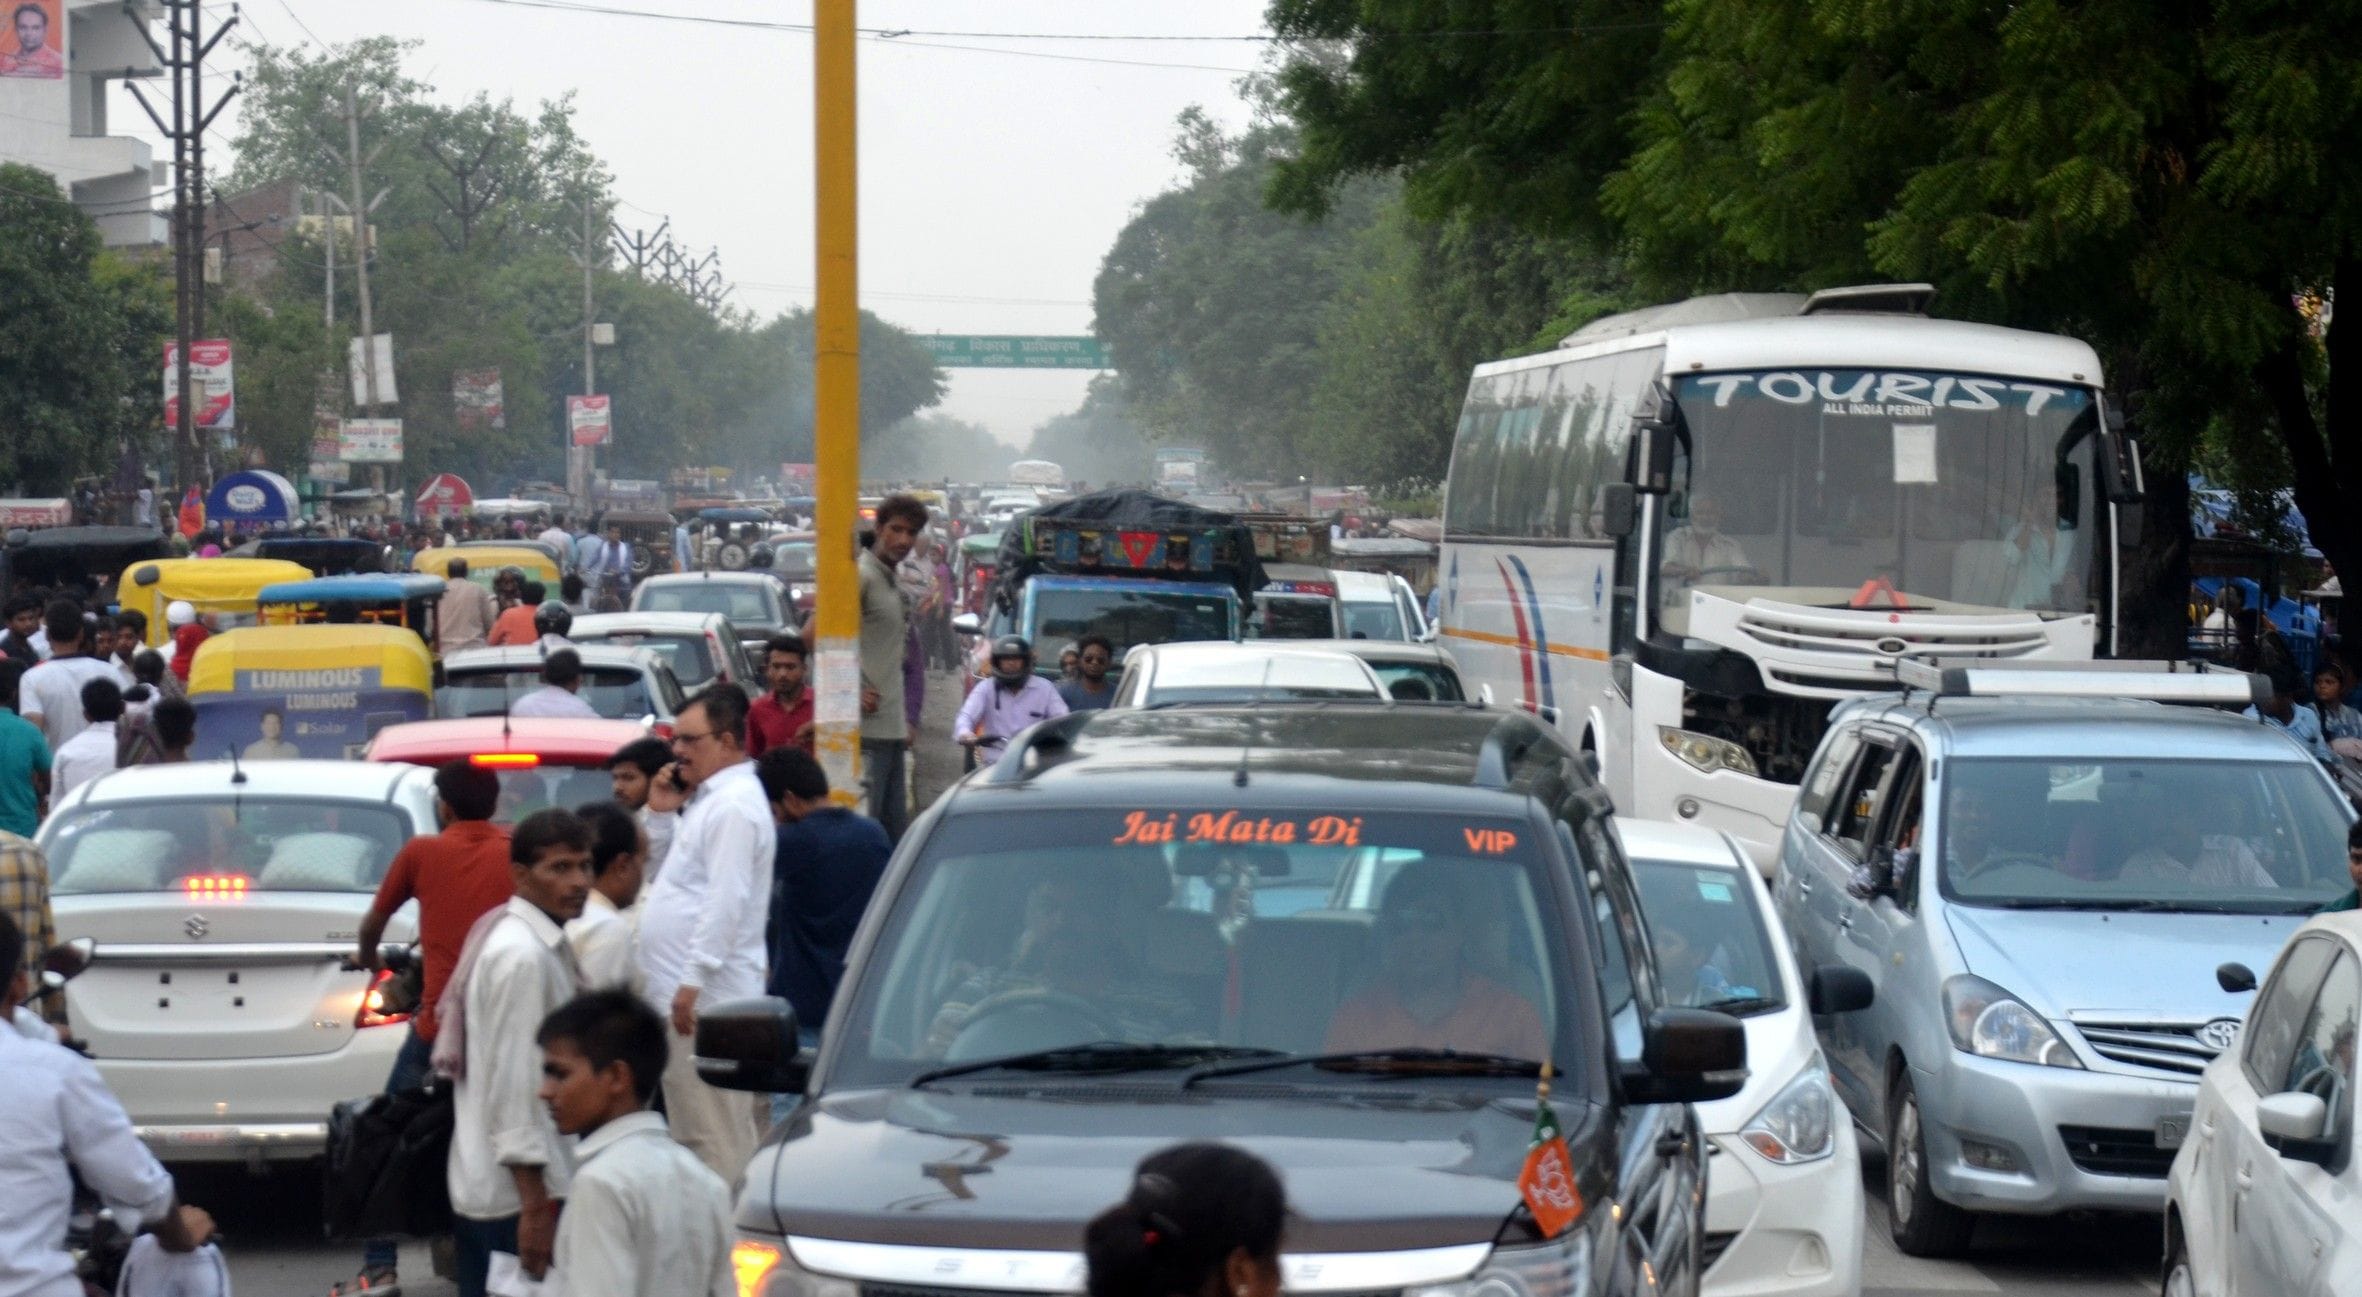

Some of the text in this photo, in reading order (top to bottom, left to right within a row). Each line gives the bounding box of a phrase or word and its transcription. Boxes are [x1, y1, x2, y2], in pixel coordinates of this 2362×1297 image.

[1696, 371, 2065, 417] TOURIST
[1822, 402, 1933, 417] ALL INDIA PERMIT
[251, 668, 363, 689] LUMINOUS
[286, 692, 358, 710] LUMINOUS
[310, 721, 347, 734] Solar
[1113, 809, 1363, 847] Jai Mata Di
[1463, 827, 1518, 854] VIP
